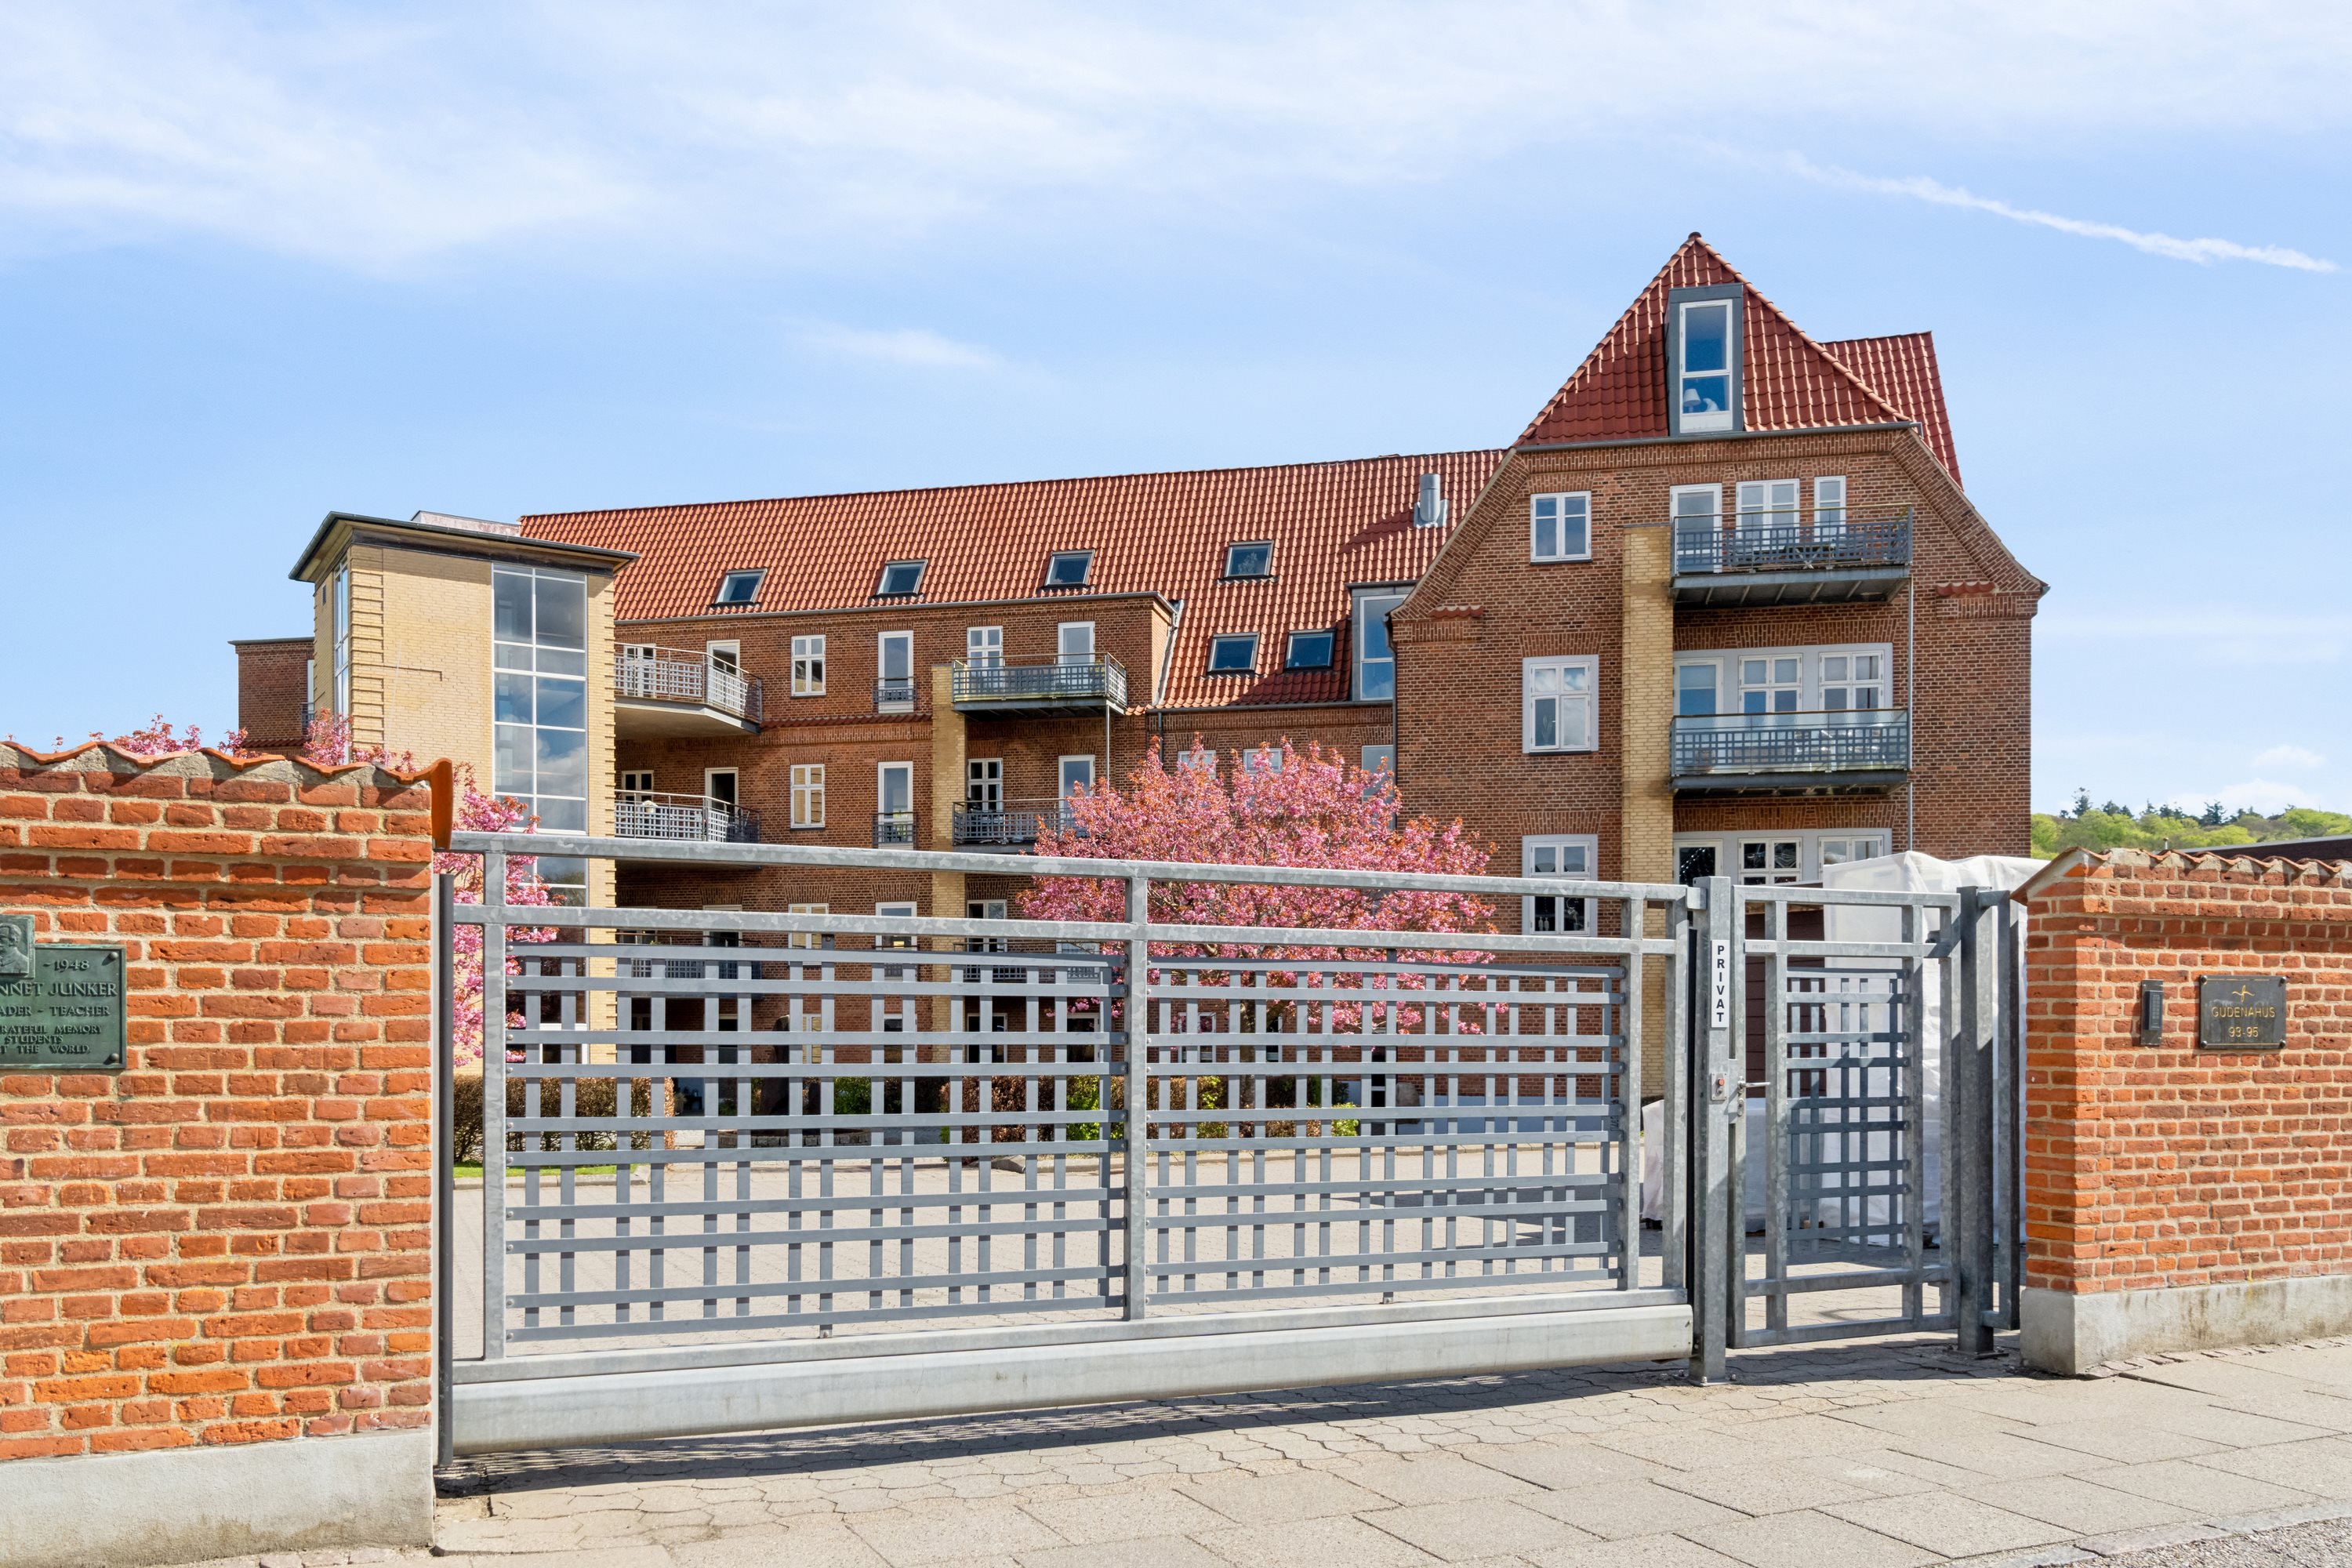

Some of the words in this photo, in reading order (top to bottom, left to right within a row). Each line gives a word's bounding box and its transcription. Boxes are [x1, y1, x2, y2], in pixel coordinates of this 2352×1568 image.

[55, 959, 89, 972] 1948
[49, 982, 118, 996] JUNKER
[1716, 945, 1725, 1022] PRIVAT
[50, 1005, 111, 1016] TEACHER
[2212, 1006, 2275, 1018] GUDENAHUS
[55, 1025, 102, 1034] MEMORY
[2229, 1026, 2259, 1037] 93-95
[5, 1035, 64, 1044] STUDENTS
[17, 1044, 39, 1054] THE
